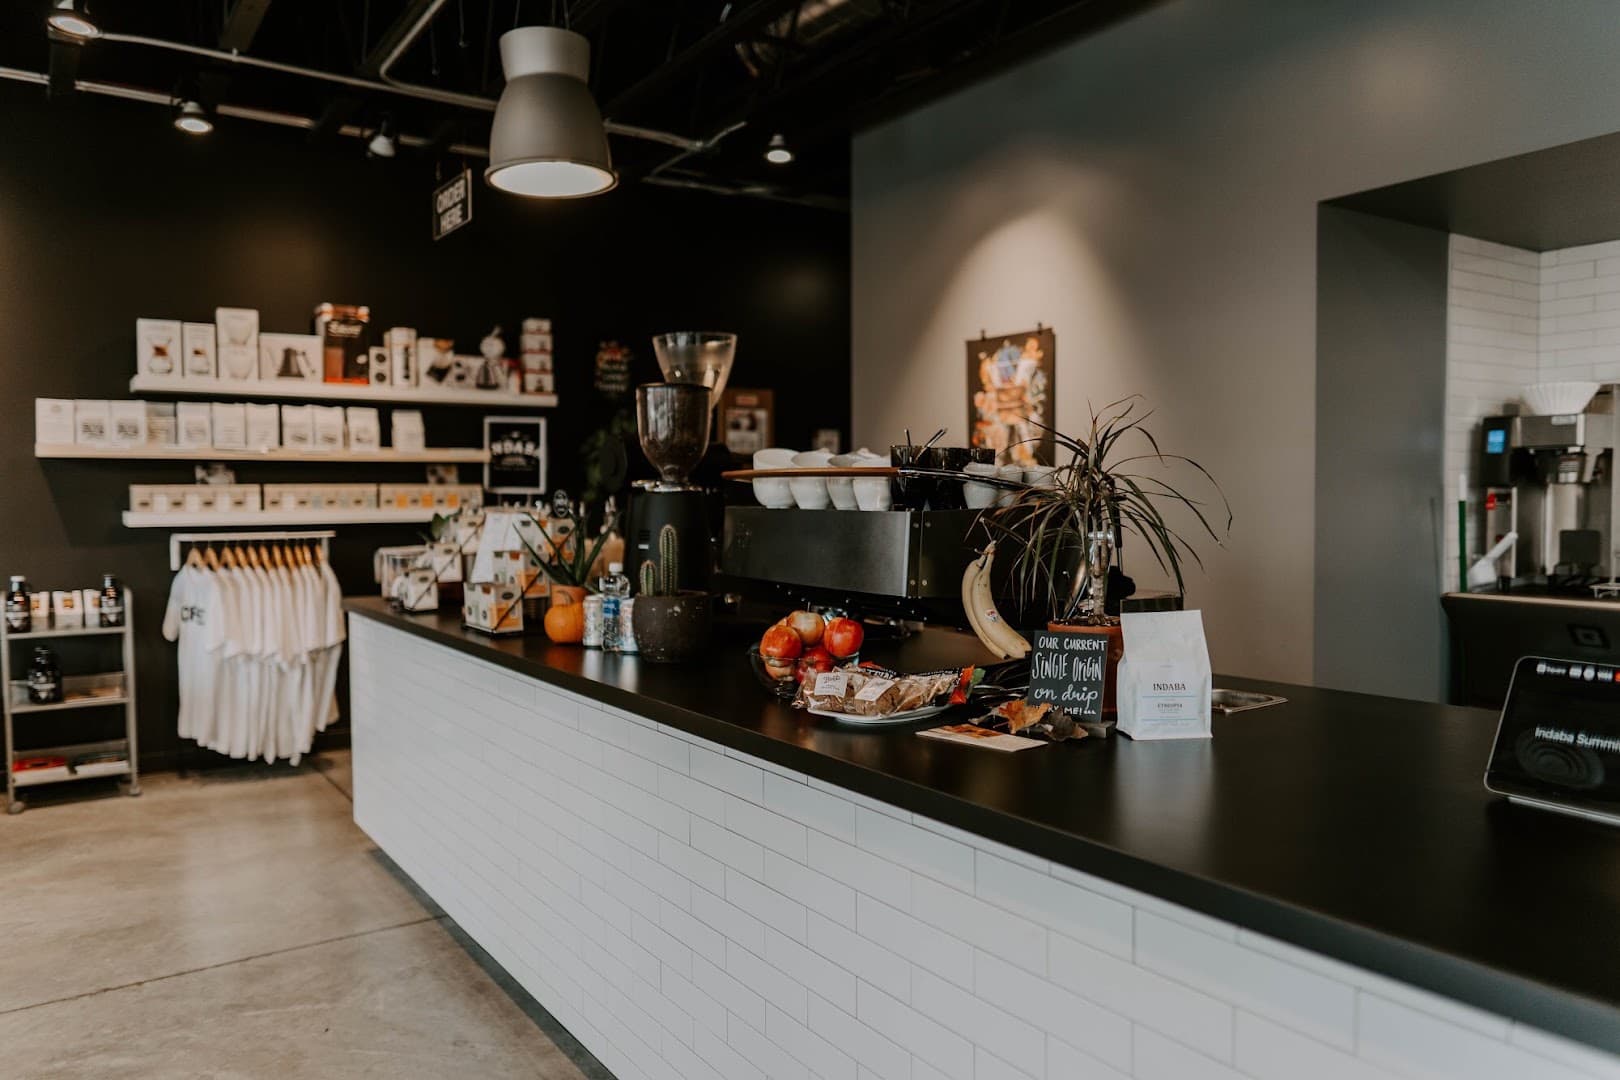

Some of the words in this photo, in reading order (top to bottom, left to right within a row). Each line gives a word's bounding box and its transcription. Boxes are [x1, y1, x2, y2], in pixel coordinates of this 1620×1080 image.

[1038, 636, 1059, 650] OUR
[1063, 637, 1108, 652] CURRENT
[1152, 683, 1186, 691] INDABA
[1034, 687, 1058, 701] on
[1061, 683, 1099, 711] drip
[1534, 727, 1575, 745] Indaba
